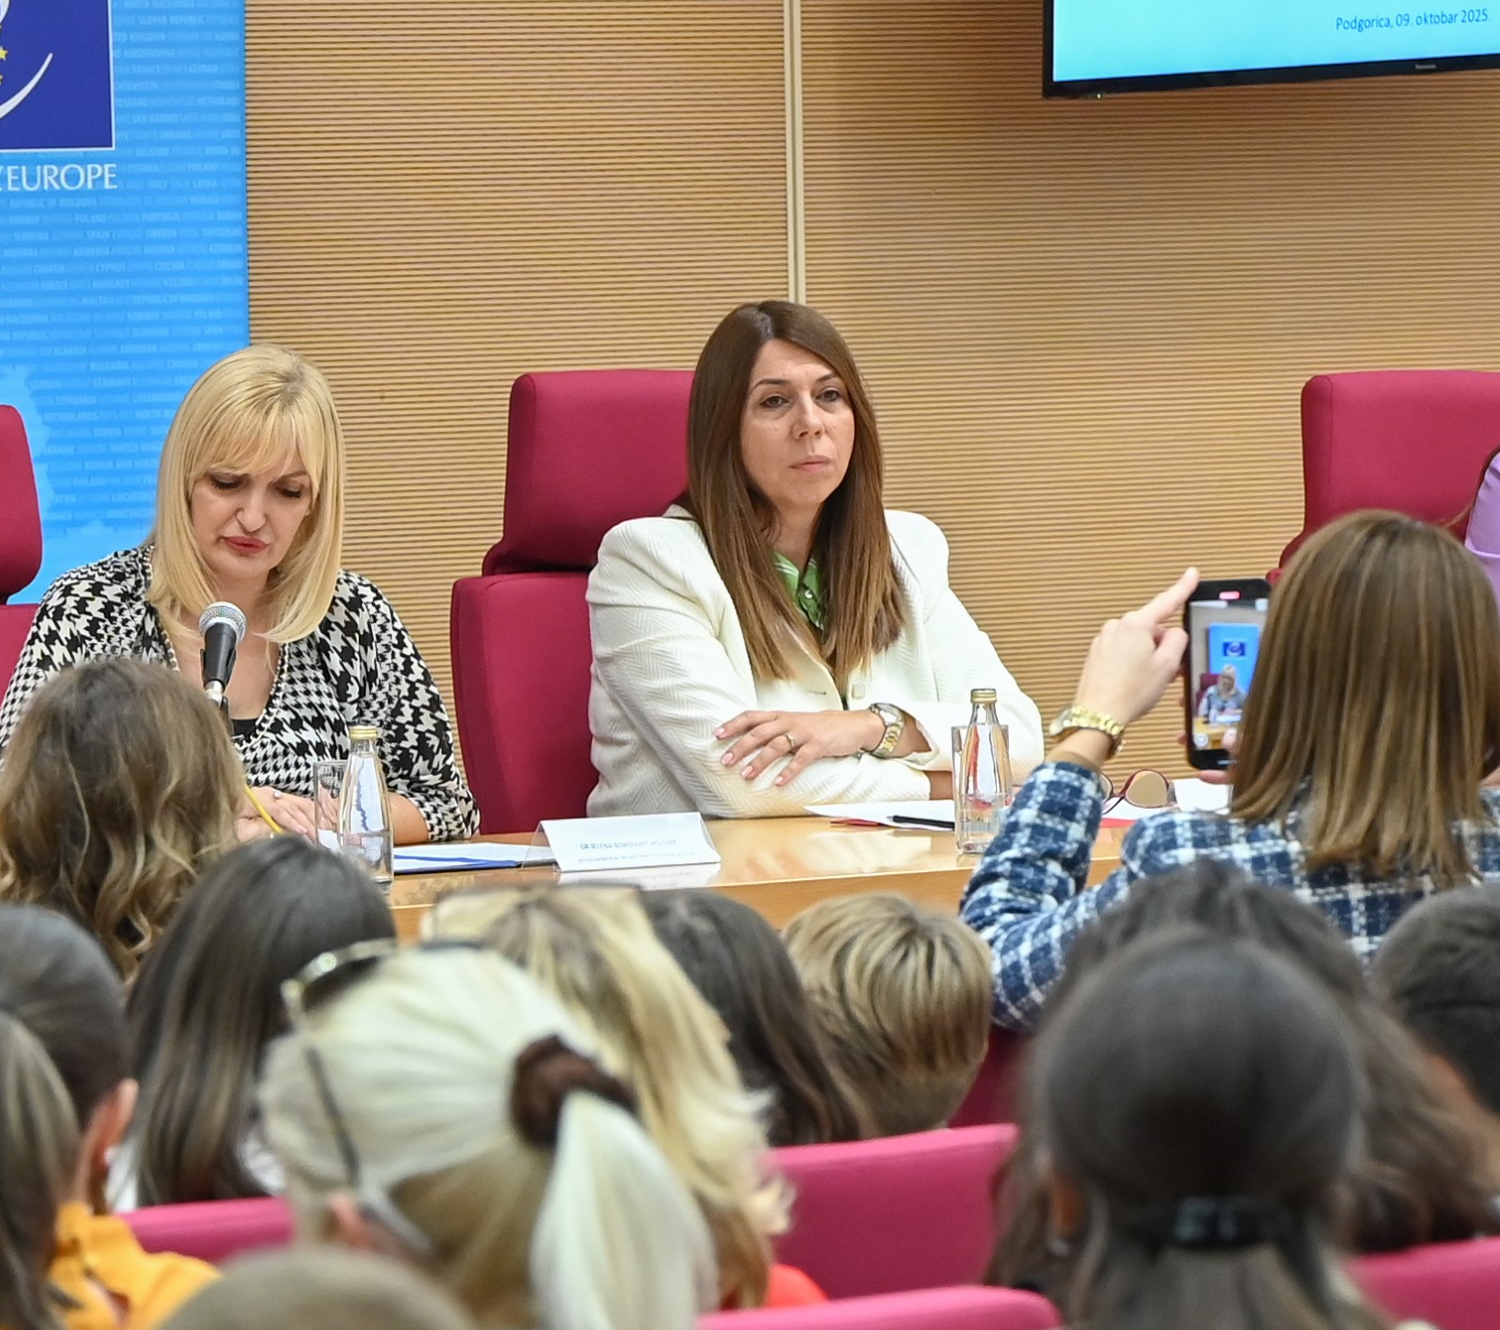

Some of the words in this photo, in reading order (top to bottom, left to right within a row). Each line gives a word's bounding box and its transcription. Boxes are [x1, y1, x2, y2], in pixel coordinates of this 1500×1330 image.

[1336, 17, 1393, 33] Podgorica,
[1396, 13, 1413, 27] 09.
[1416, 11, 1458, 26] oktobar
[1461, 8, 1491, 23] 2025.
